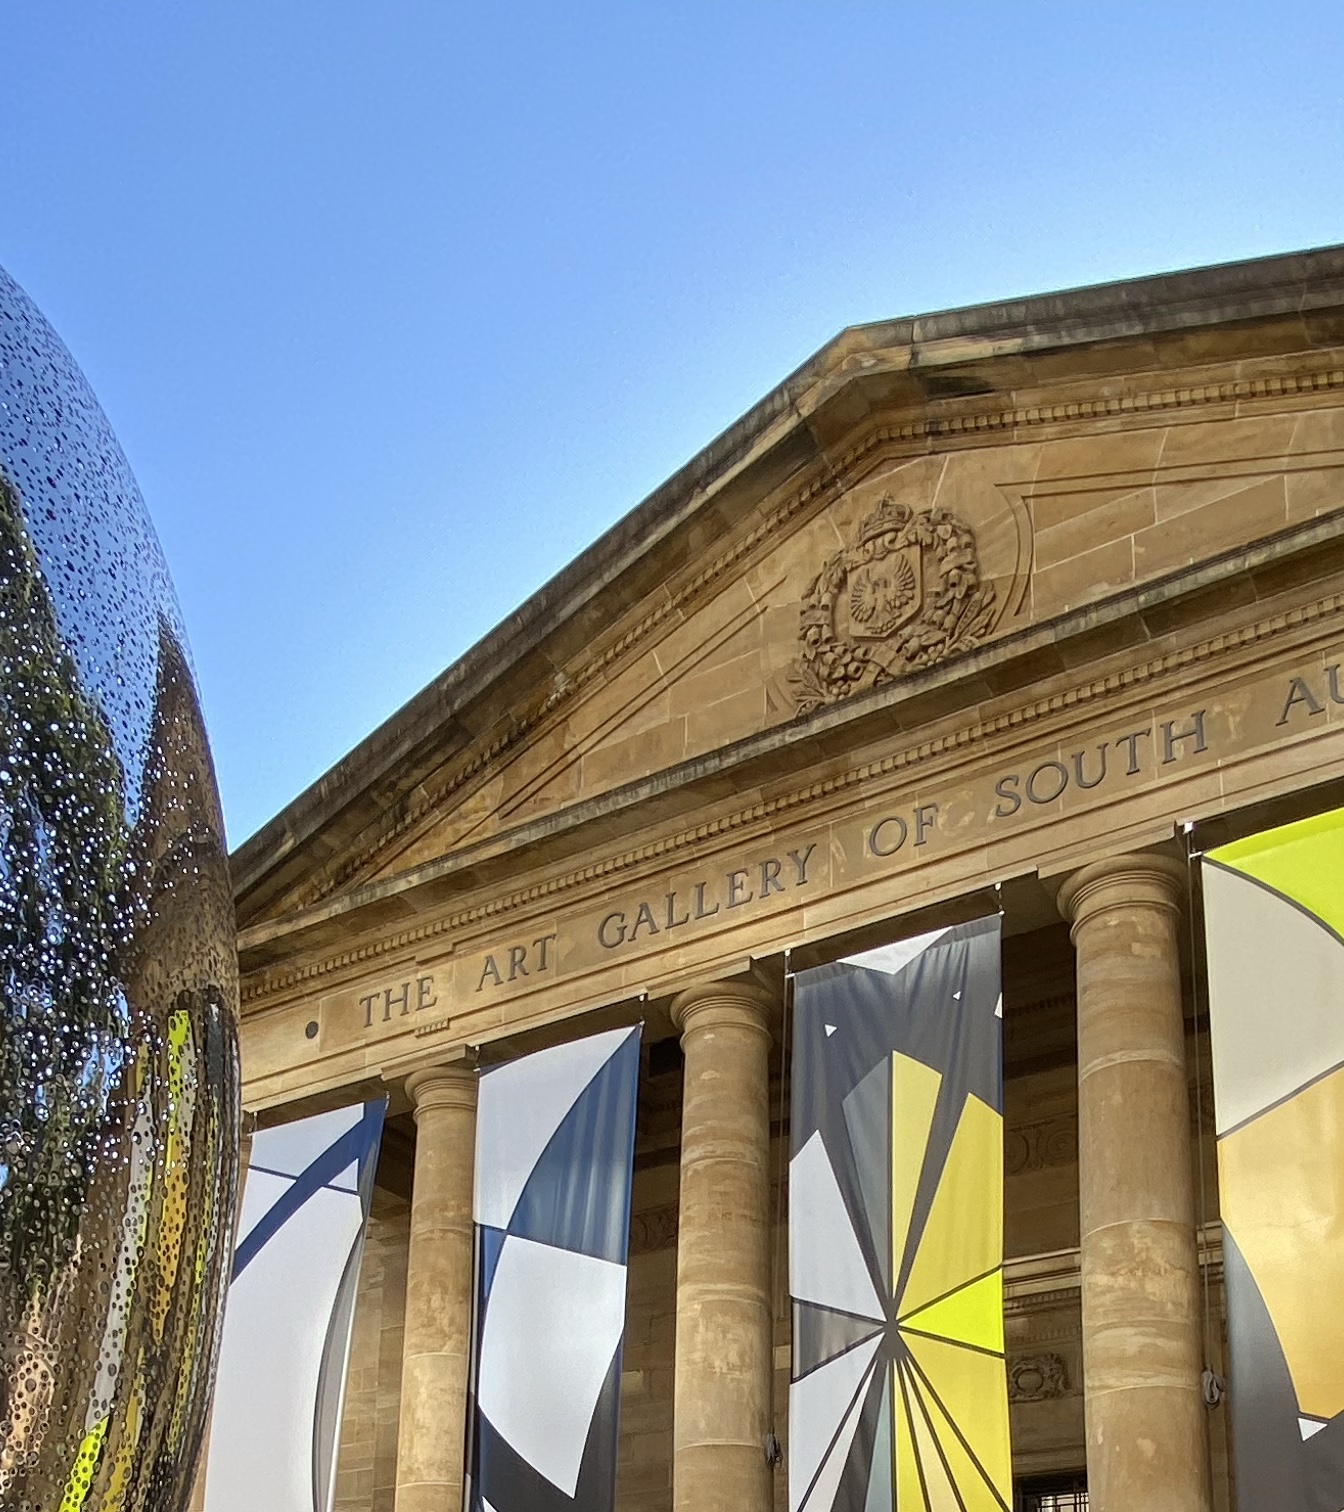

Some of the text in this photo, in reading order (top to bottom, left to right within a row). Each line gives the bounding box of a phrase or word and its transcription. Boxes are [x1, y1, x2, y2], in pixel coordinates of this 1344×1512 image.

[359, 975, 438, 1028] THE
[475, 933, 558, 993] ART
[597, 843, 817, 950] GALLERY
[868, 804, 940, 858] OF
[994, 708, 1208, 818] SOUTH
